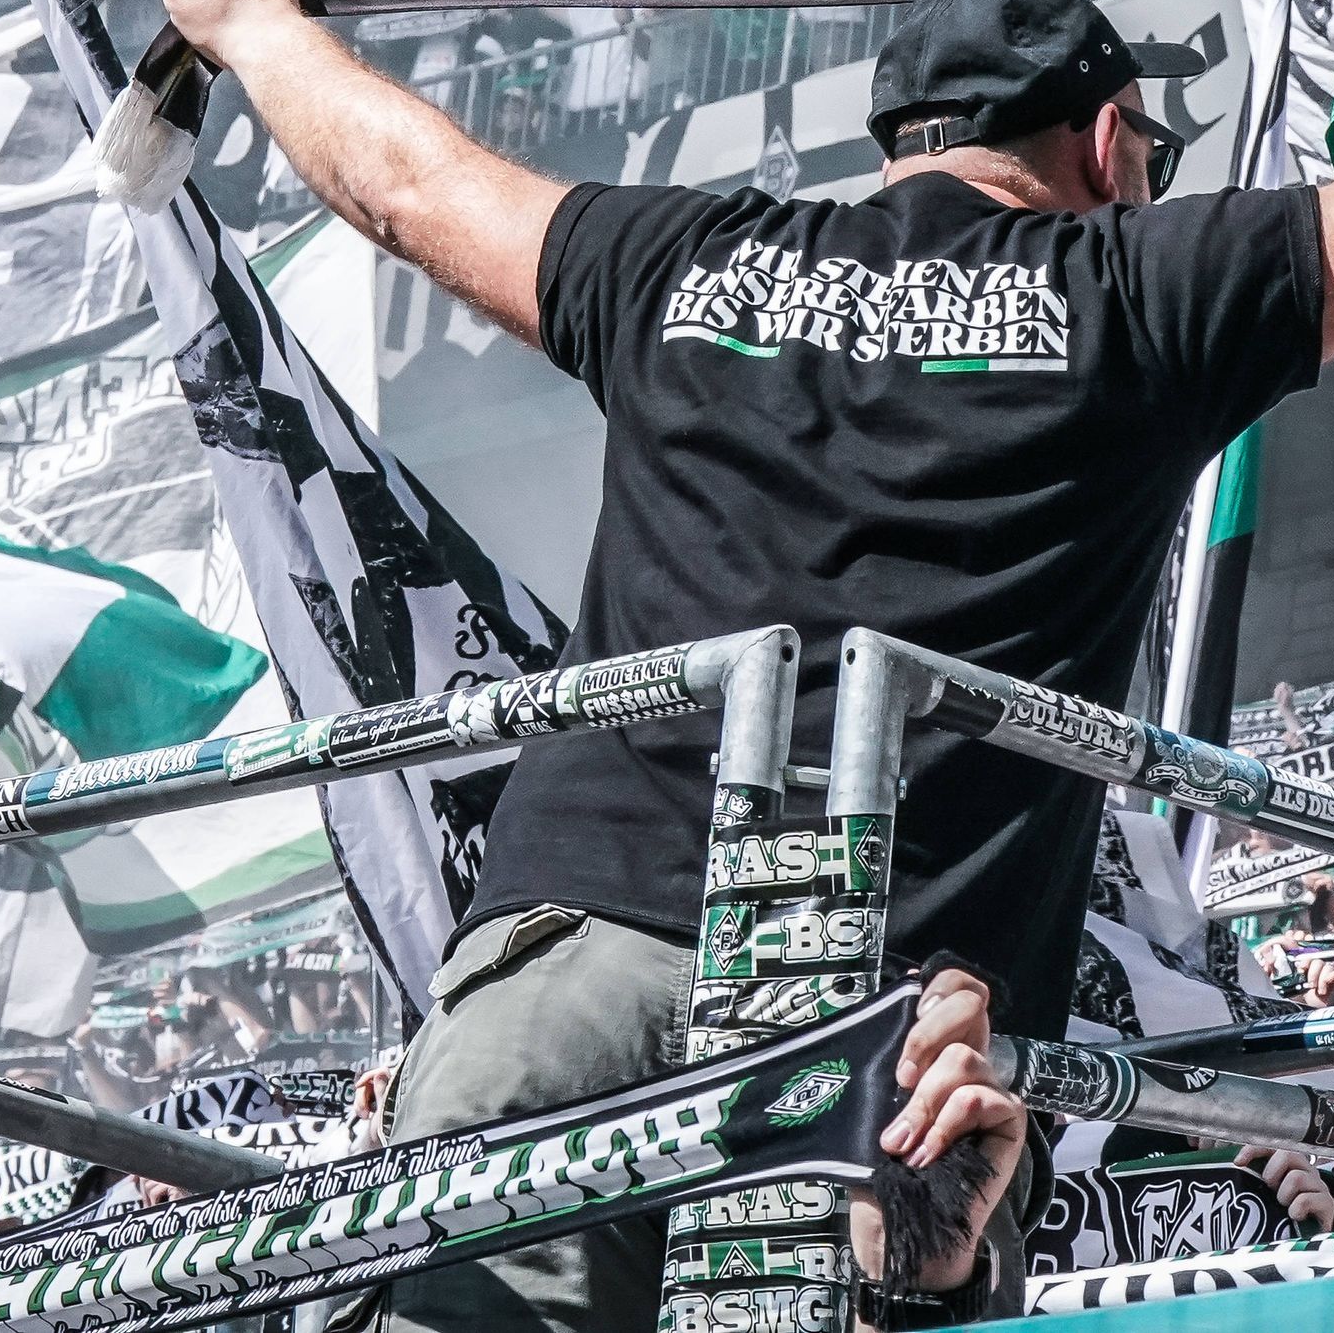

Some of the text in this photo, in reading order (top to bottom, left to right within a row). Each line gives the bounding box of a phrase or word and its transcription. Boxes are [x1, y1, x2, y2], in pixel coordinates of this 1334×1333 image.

[680, 262, 1068, 335] UNSEREN FARBEN
[809, 256, 973, 306] STEHEN
[981, 262, 1049, 294] ZU
[662, 290, 1070, 363] BIS WIR STERBEN
[579, 652, 687, 696] MODERNEN
[1015, 695, 1131, 758] CULTURA
[1270, 784, 1306, 814] ALS
[55, 1229, 101, 1261] Weg,
[108, 1215, 146, 1250] den
[152, 1203, 181, 1237] du
[186, 1192, 244, 1236] gehst,
[252, 1175, 309, 1218] gehst
[313, 1164, 341, 1200] du
[347, 1153, 404, 1192] nicht
[408, 1134, 485, 1181] alleine.
